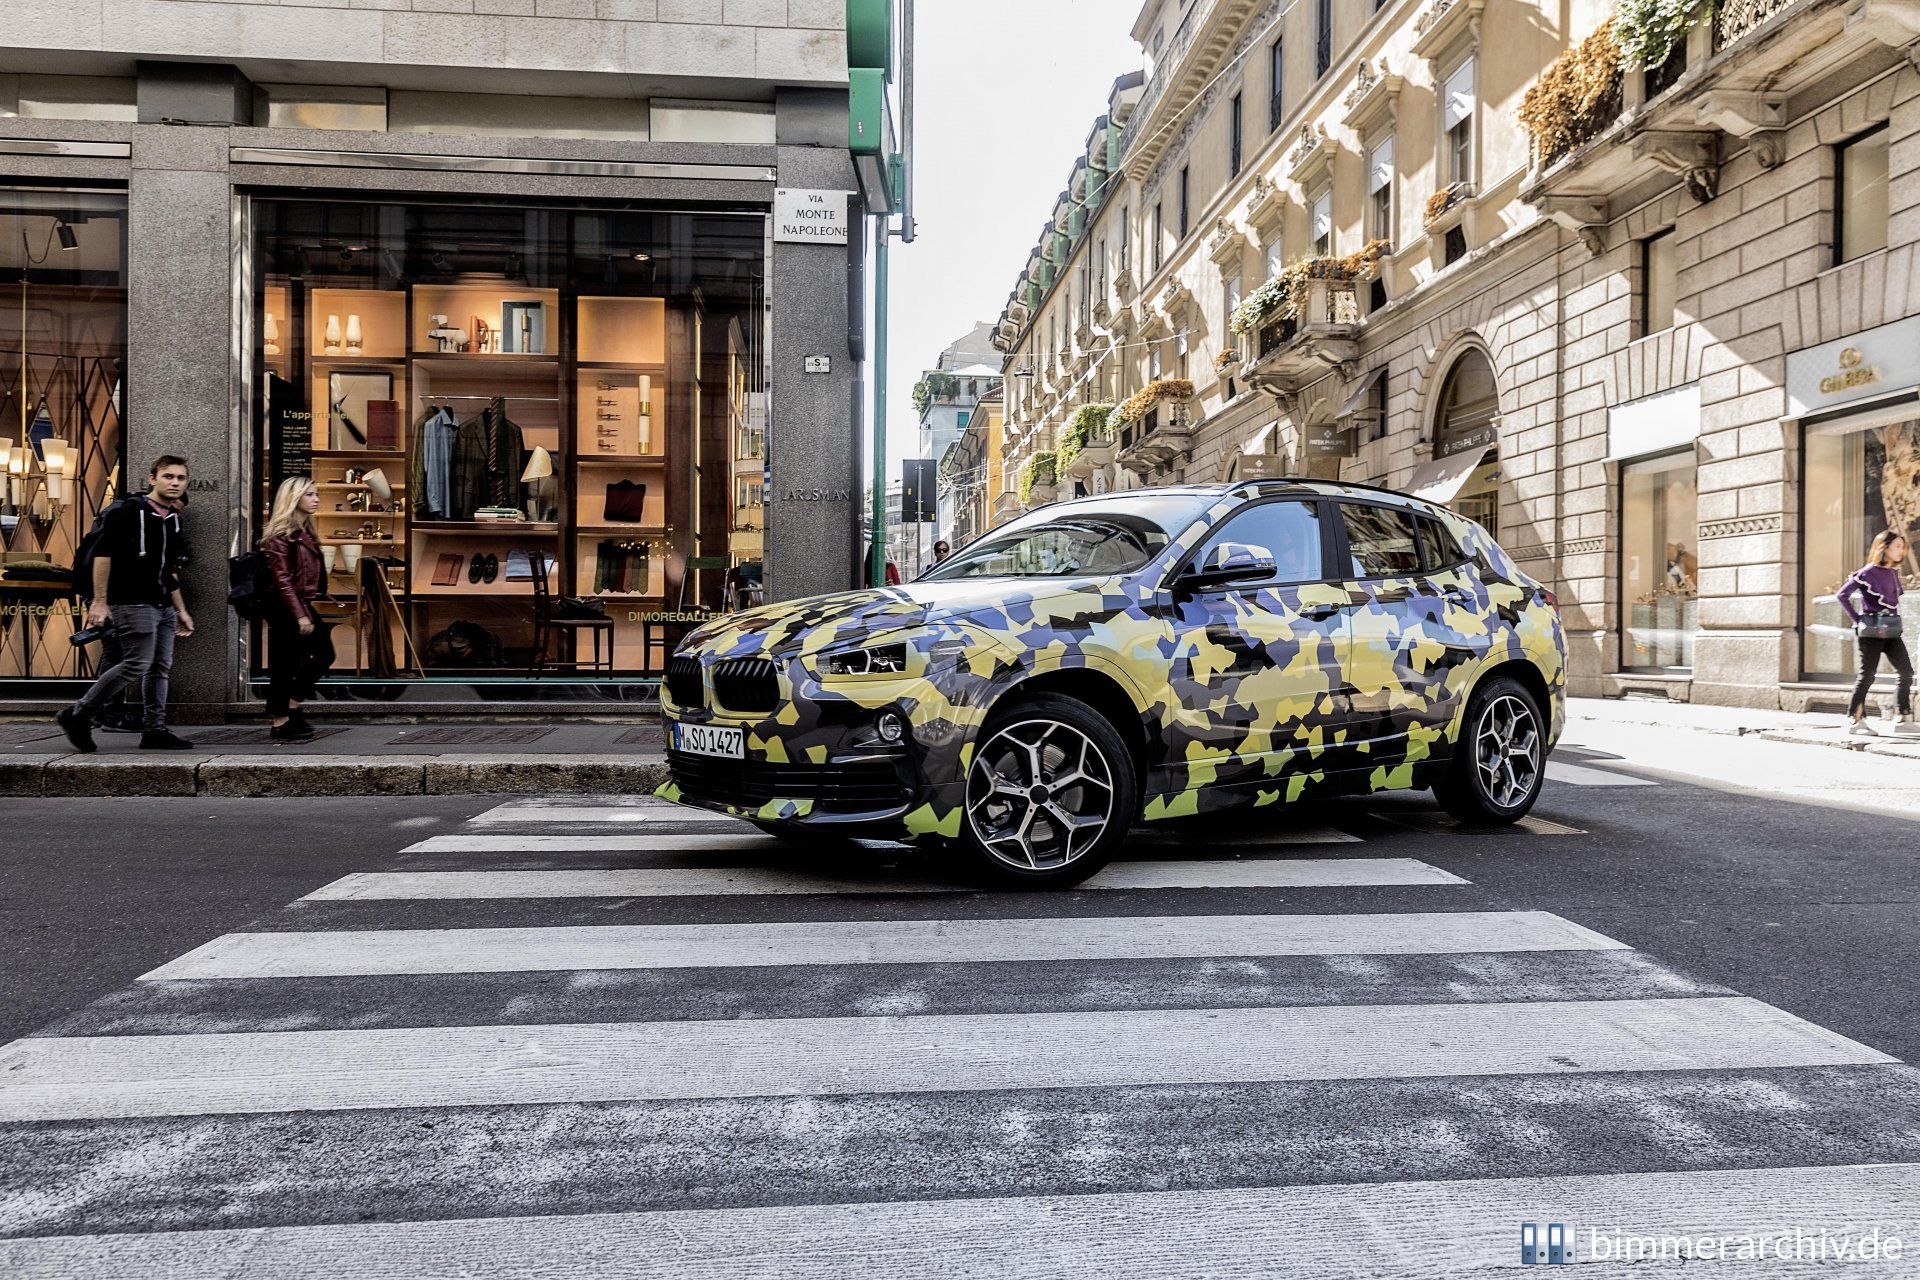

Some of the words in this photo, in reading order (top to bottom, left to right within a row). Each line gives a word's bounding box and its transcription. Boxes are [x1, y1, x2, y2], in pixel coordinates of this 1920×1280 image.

[808, 195, 823, 203] VIA
[796, 209, 835, 220] MONTE
[783, 224, 848, 237] NAPOLEONE
[814, 358, 821, 367] S
[692, 727, 707, 752] SO
[708, 729, 742, 756] 1427
